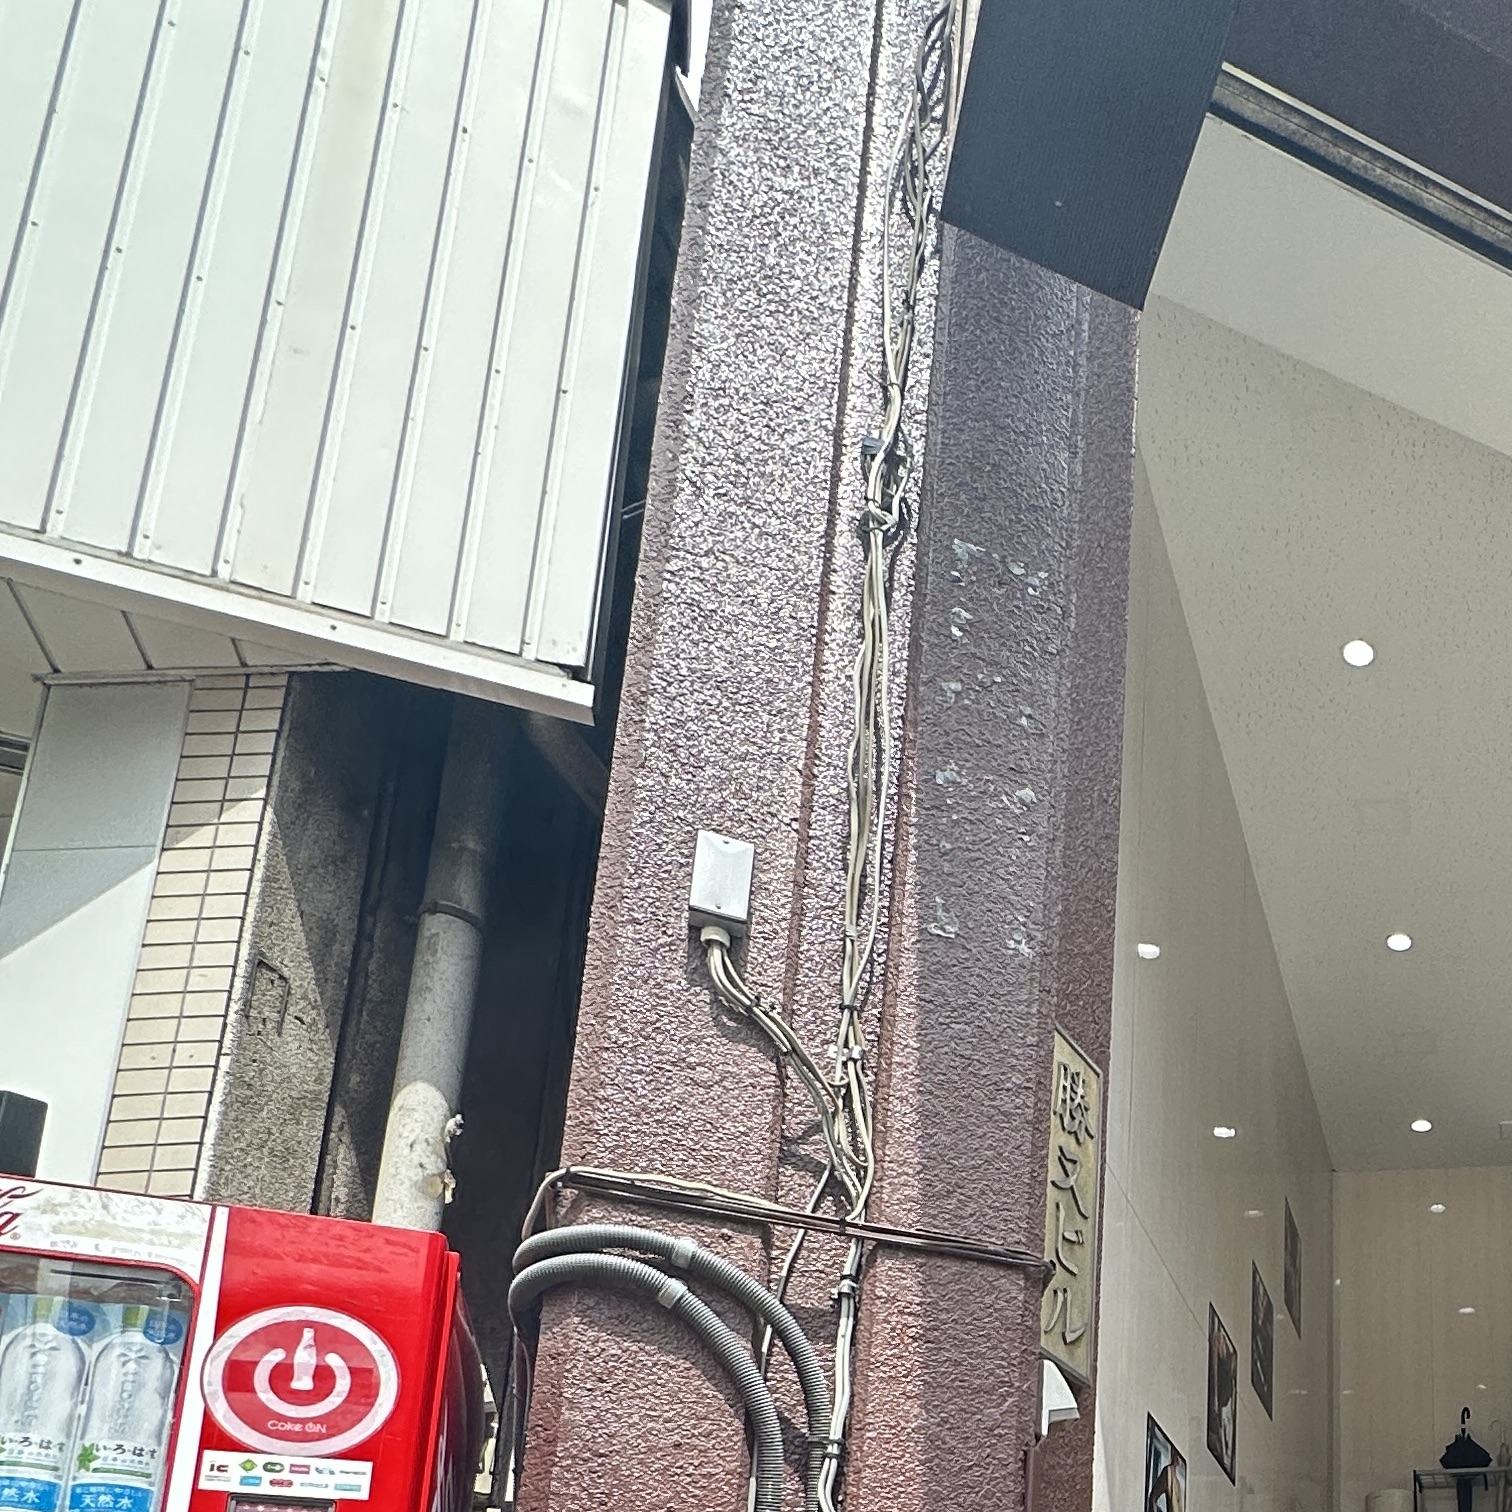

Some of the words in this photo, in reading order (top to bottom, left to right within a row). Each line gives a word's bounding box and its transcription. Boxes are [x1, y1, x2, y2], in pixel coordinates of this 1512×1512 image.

[1044, 1061, 1096, 1345] 勝又ビル
[268, 1420, 303, 1431] Coke
[305, 1421, 327, 1433] ON
